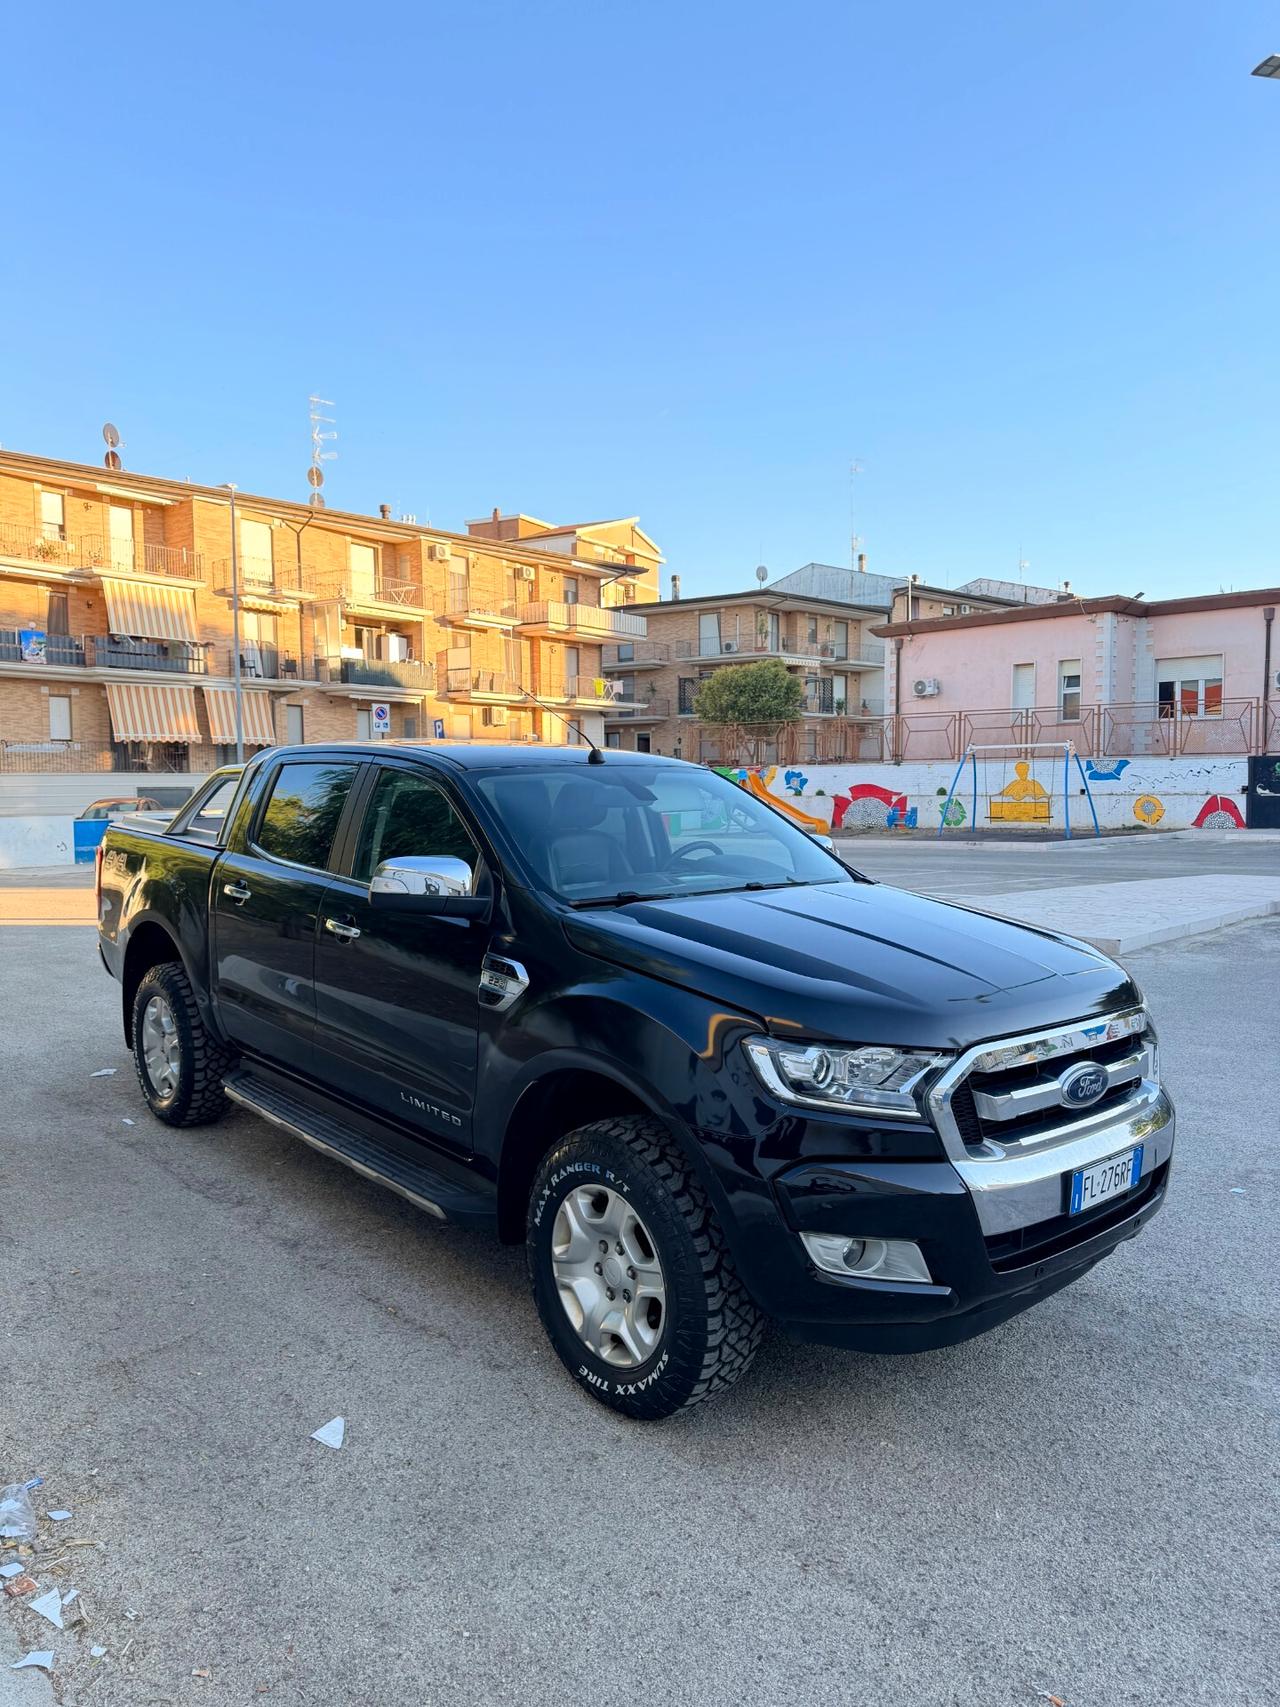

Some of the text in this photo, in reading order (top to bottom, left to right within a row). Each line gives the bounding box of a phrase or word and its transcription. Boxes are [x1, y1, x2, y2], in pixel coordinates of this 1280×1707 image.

[436, 721, 444, 739] P
[1077, 1074, 1103, 1098] Ford
[400, 1091, 462, 1127] LIMITED
[533, 1162, 631, 1227] MAX RANGER R/T
[578, 1349, 669, 1396] SUMAXX TIRE
